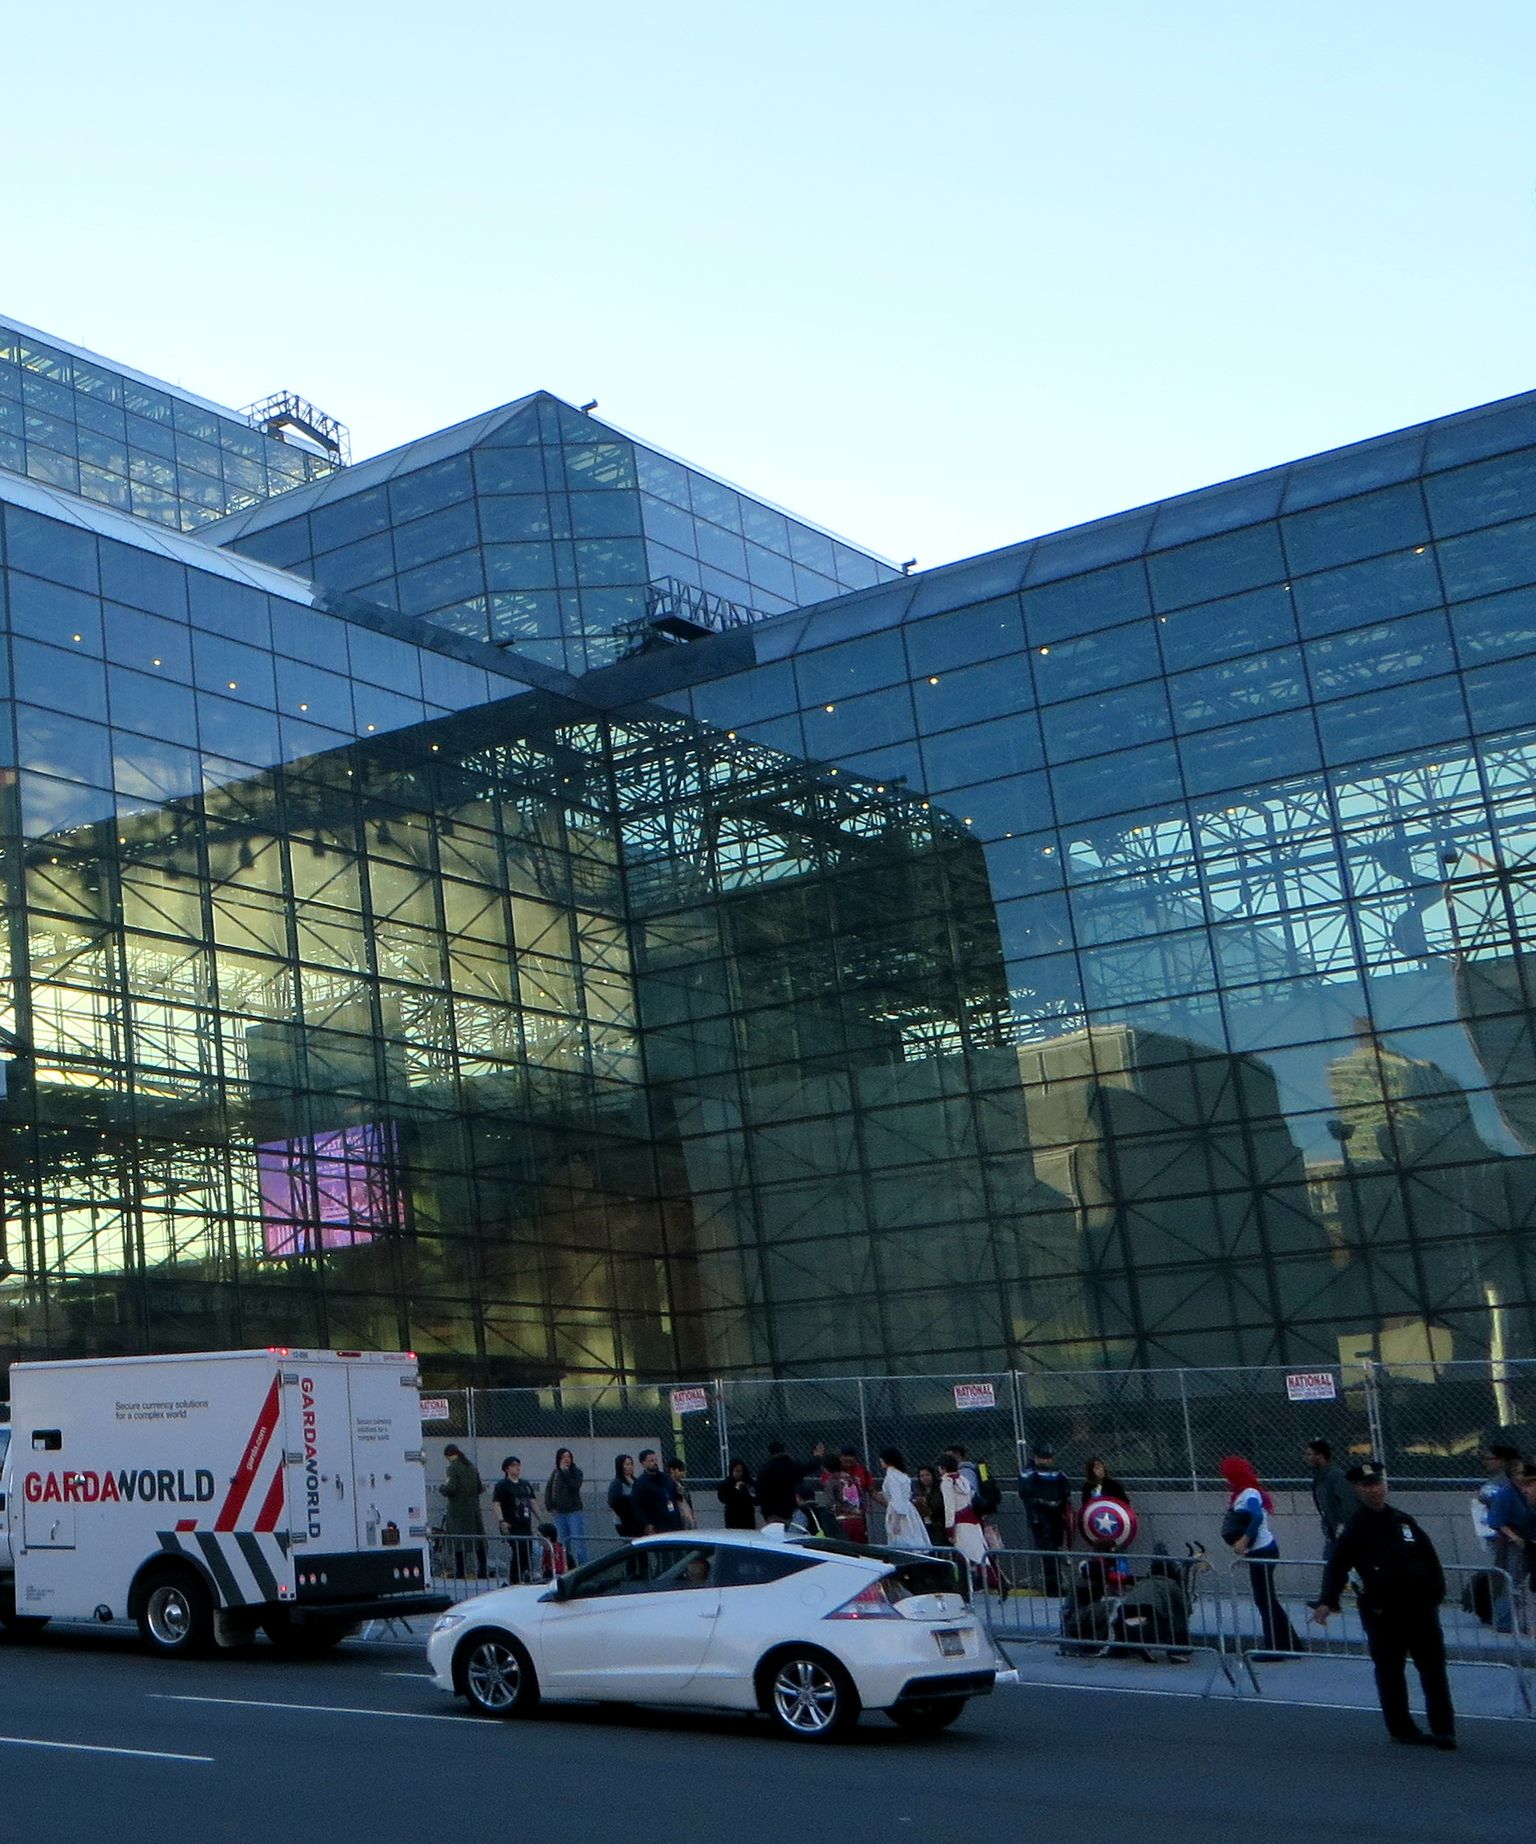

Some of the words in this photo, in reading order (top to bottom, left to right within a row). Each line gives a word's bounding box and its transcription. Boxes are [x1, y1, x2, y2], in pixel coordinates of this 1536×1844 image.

[1288, 1374, 1332, 1388] NATIONAL
[673, 1389, 704, 1402] NATIONAL
[955, 1384, 992, 1397] NATIONAL
[115, 1401, 141, 1411] Secure
[142, 1401, 174, 1411] currency
[175, 1400, 209, 1409] solutions
[115, 1412, 126, 1420] for
[134, 1412, 165, 1421] complex
[166, 1410, 187, 1419] world
[301, 1377, 321, 1539] GARDAWORLD
[24, 1469, 215, 1503] GARDAWORLD
